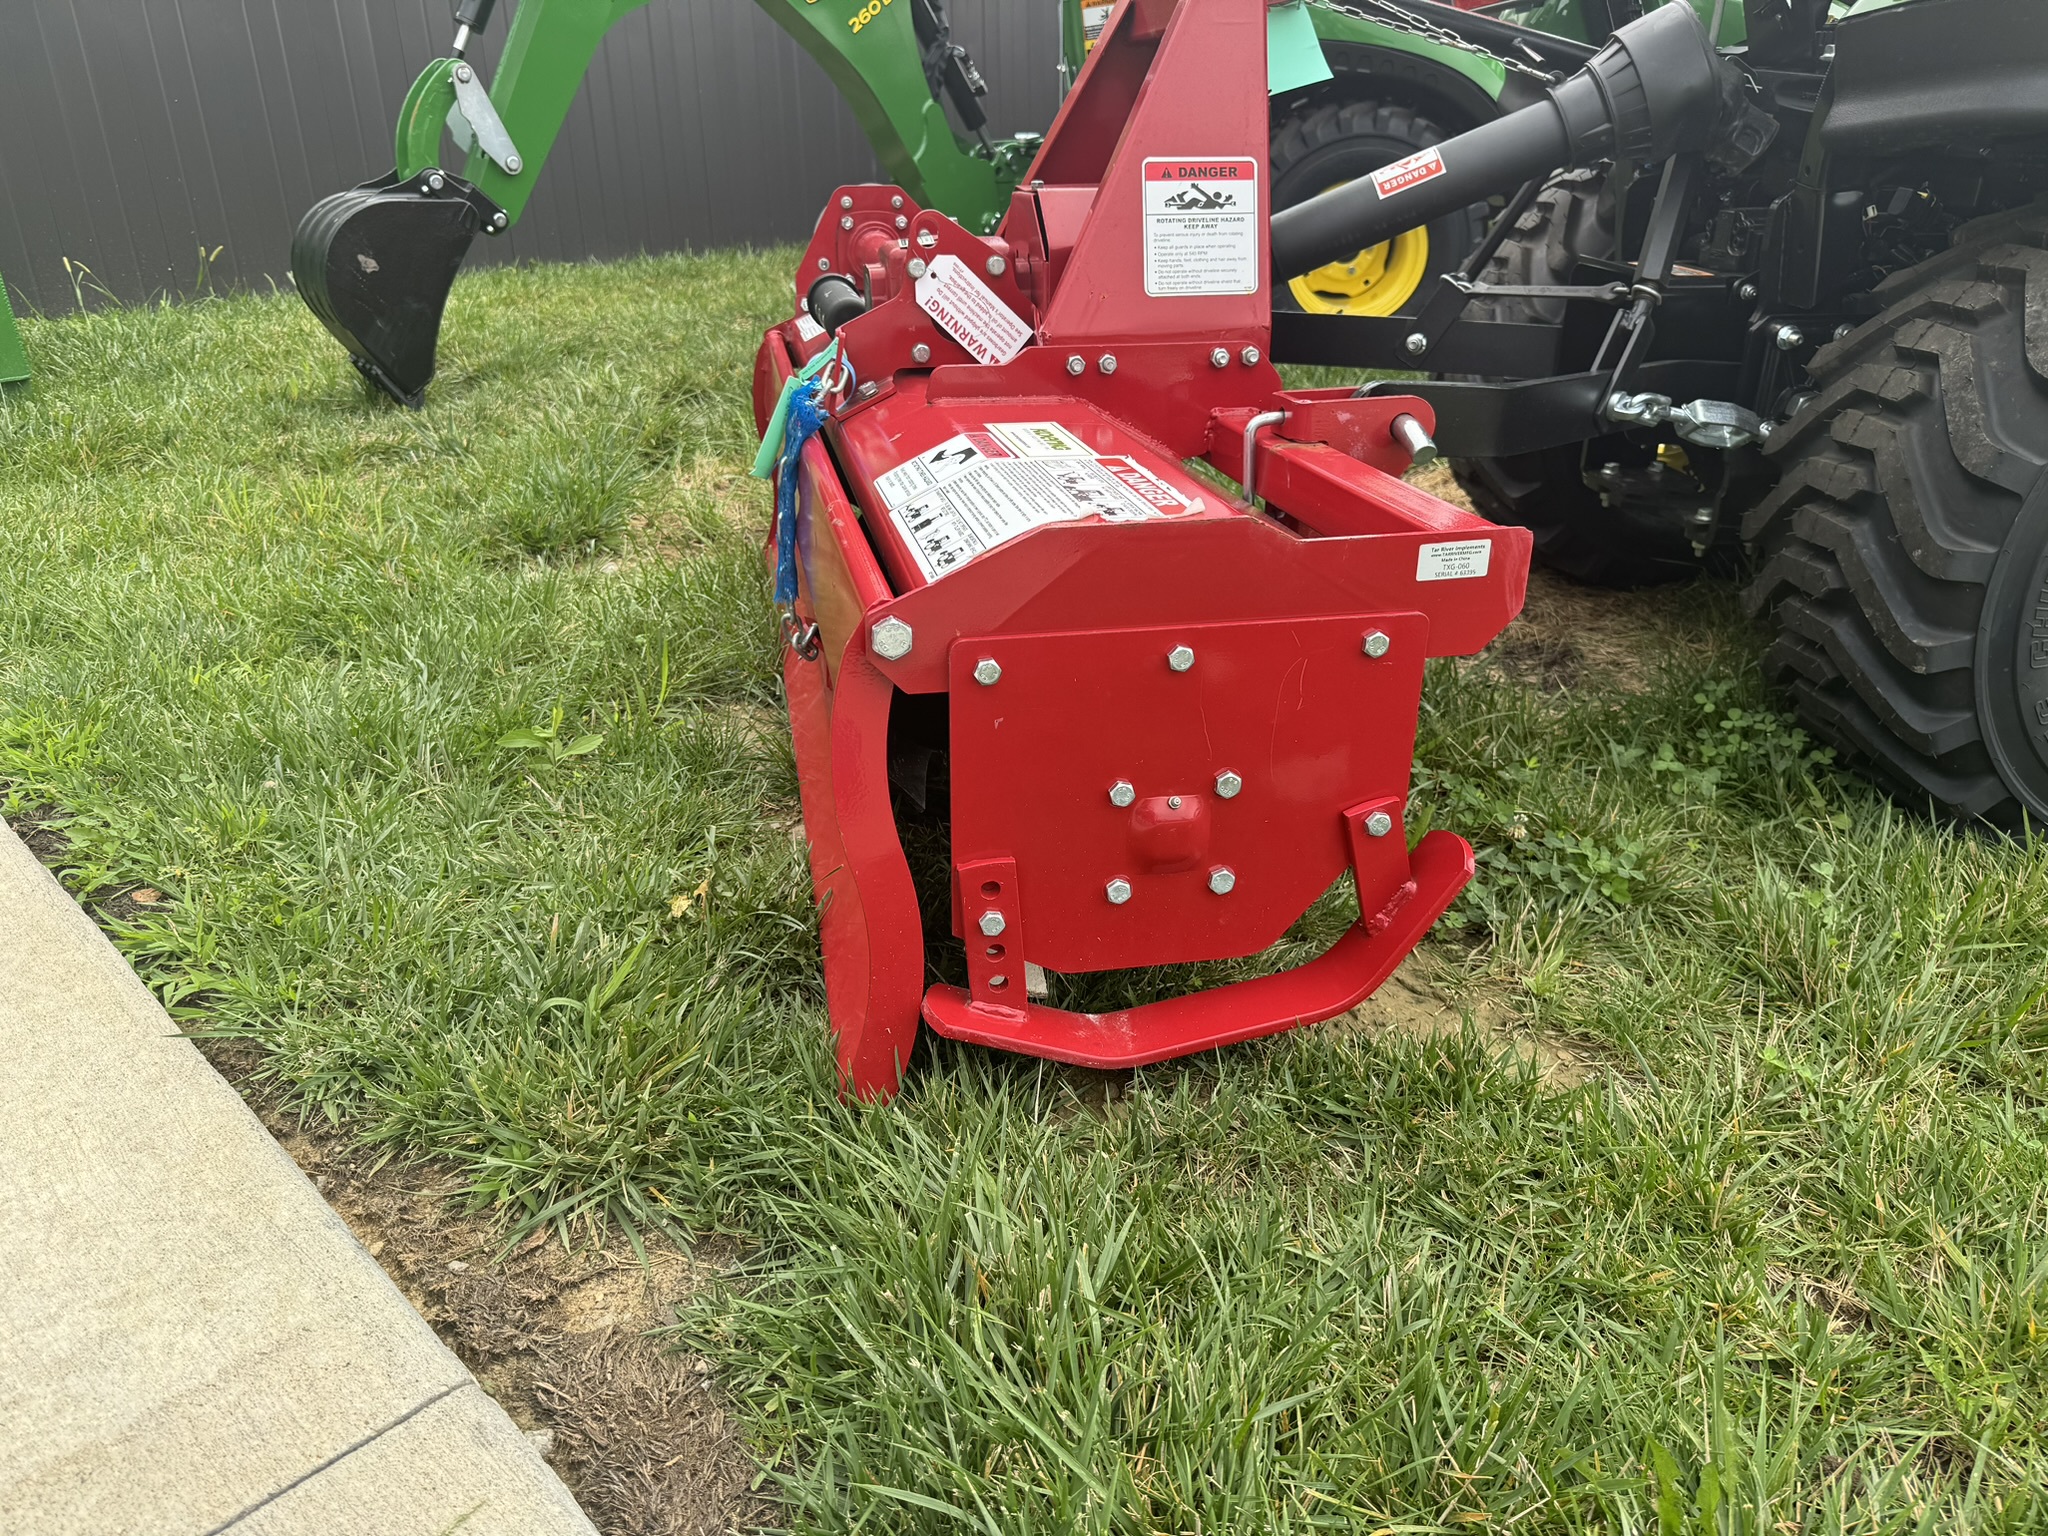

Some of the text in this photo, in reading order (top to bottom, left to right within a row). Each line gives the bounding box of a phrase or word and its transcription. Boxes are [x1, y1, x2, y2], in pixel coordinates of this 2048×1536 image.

[848, 0, 882, 34] 260
[1179, 167, 1238, 178] DANGER
[1383, 166, 1427, 190] DANGER
[943, 282, 958, 297] correct
[948, 300, 965, 315] without
[956, 296, 967, 305] until
[975, 302, 989, 315] added
[978, 295, 995, 311] Manual
[966, 305, 982, 321] machine
[994, 308, 1015, 330] Operator's
[923, 295, 988, 359] WARNING!
[963, 314, 980, 330] shipped
[989, 326, 1005, 342] operate
[1001, 326, 1017, 342] amount
[1014, 327, 1022, 337] See
[985, 335, 1006, 356] Gearboxes
[1004, 340, 1012, 349] not
[1117, 472, 1179, 506] DANGER
